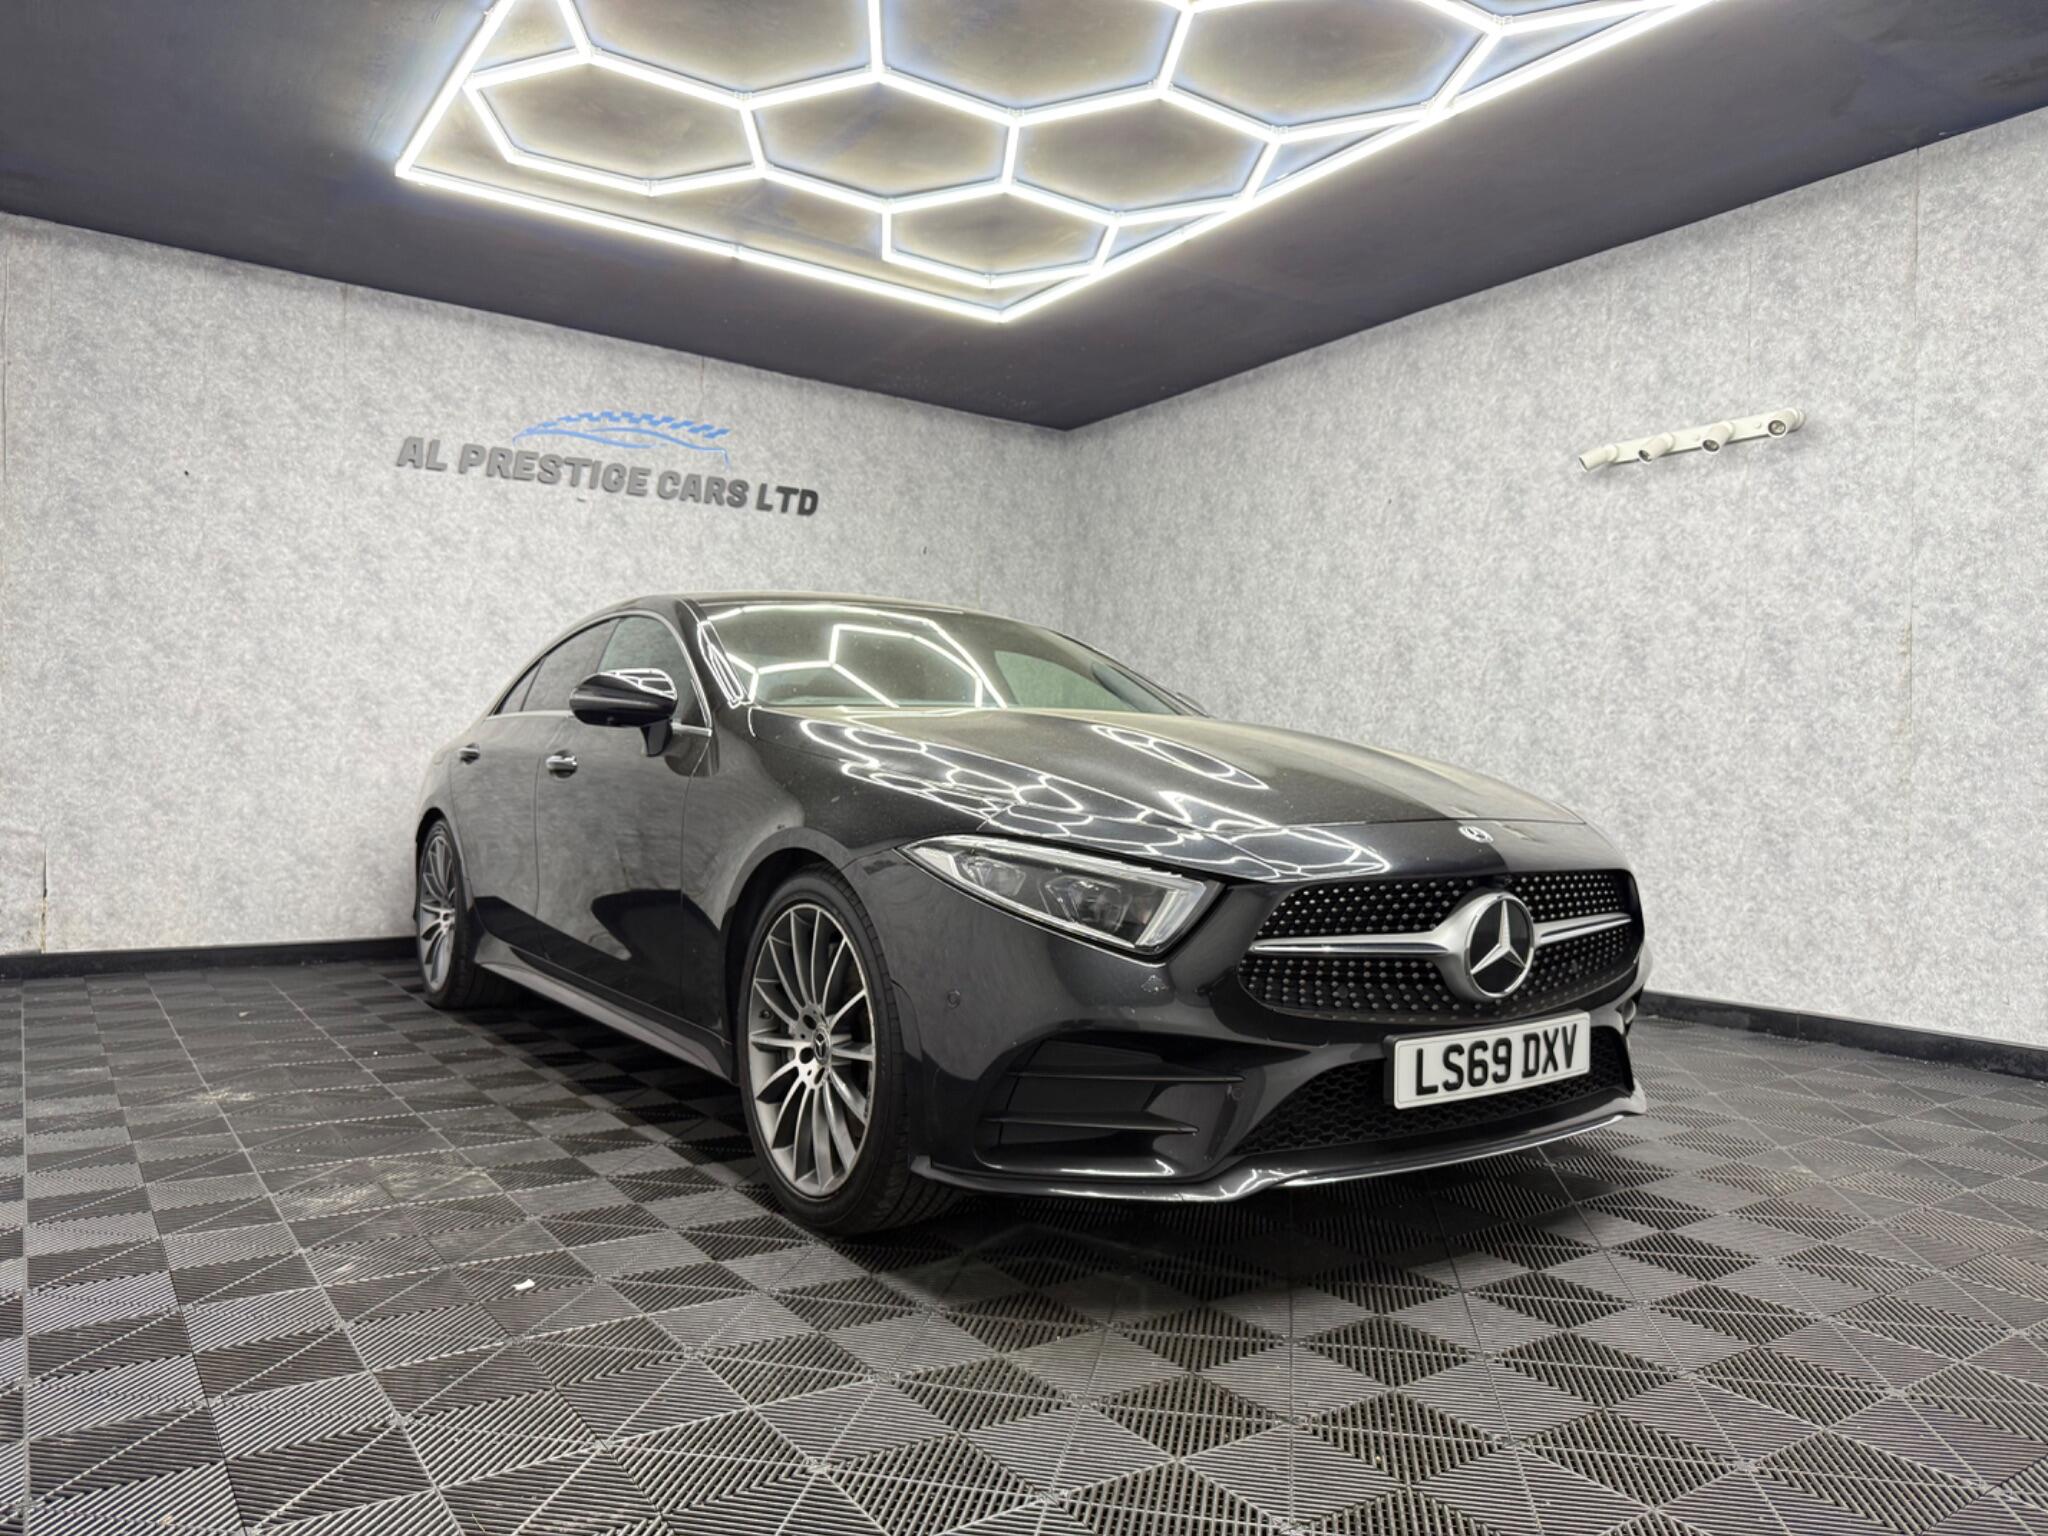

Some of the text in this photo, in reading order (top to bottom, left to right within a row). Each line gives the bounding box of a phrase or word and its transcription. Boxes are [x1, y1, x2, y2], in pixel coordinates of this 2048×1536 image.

[396, 436, 819, 516] AL PRESTIGE CARS LTD
[1416, 1023, 1577, 1096] LS69 DXV
